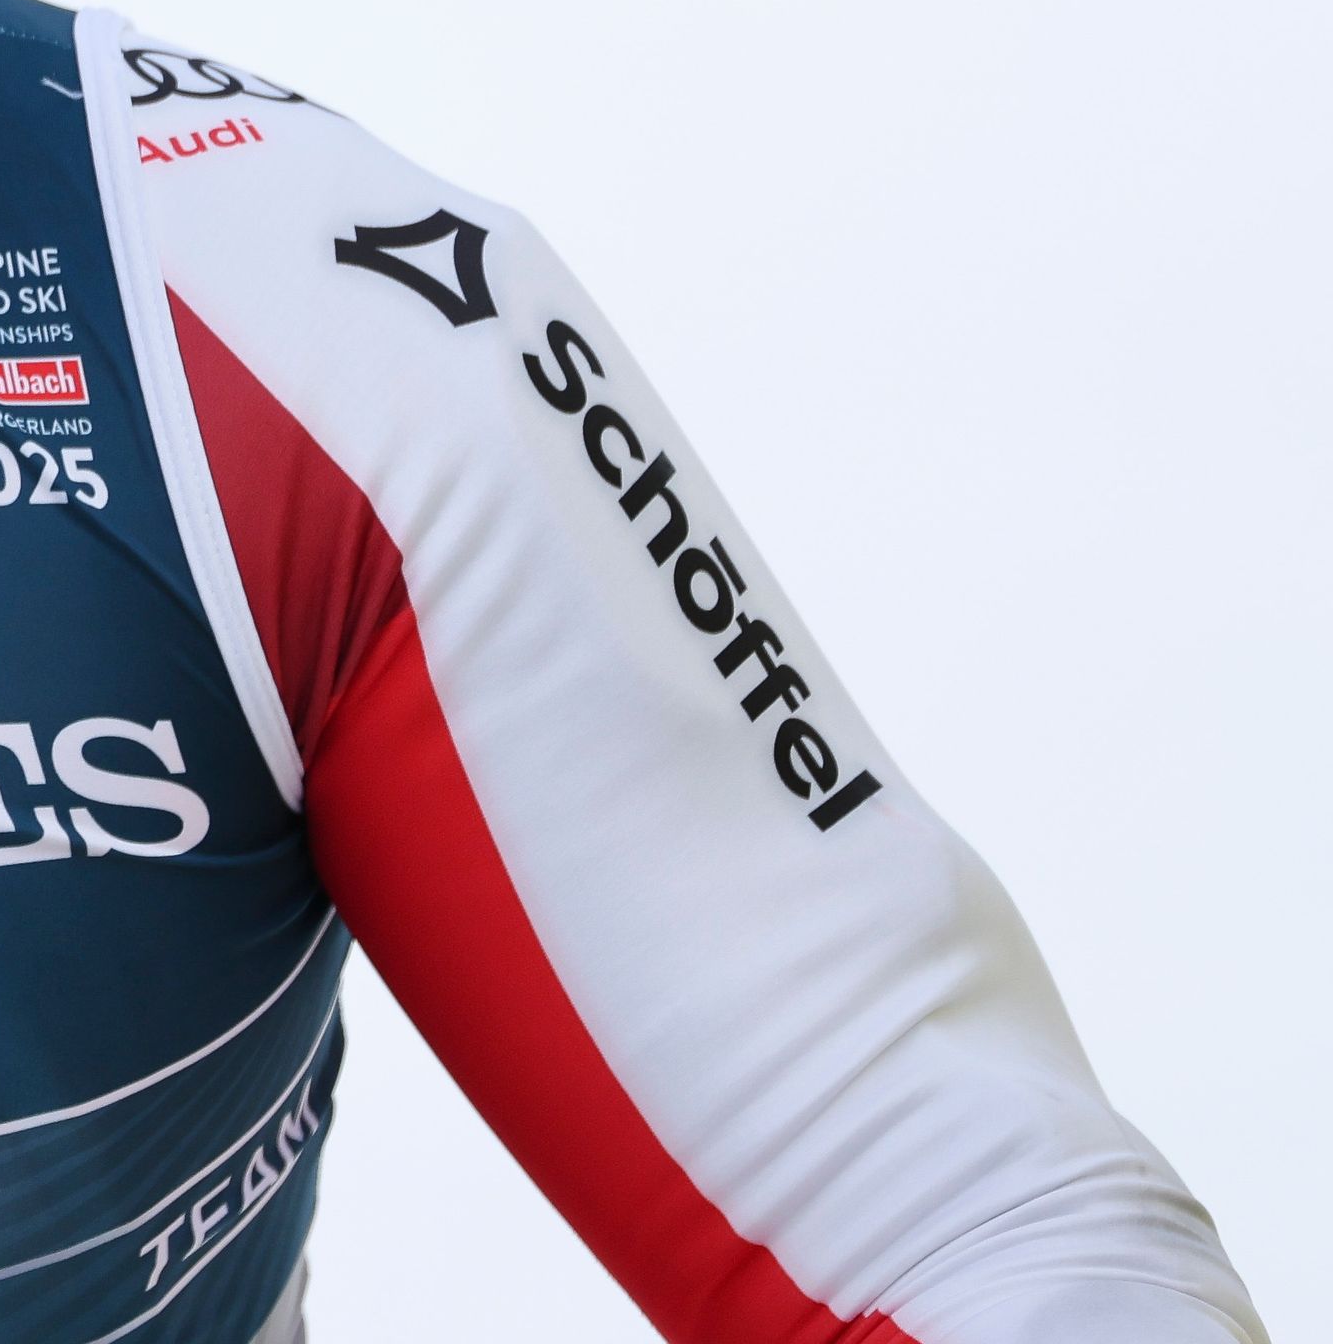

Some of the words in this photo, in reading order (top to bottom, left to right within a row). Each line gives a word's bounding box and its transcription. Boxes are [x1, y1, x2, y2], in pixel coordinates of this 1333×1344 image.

[137, 118, 263, 163] Audi
[19, 284, 68, 314] SKI
[140, 1076, 319, 1292] TEAM
